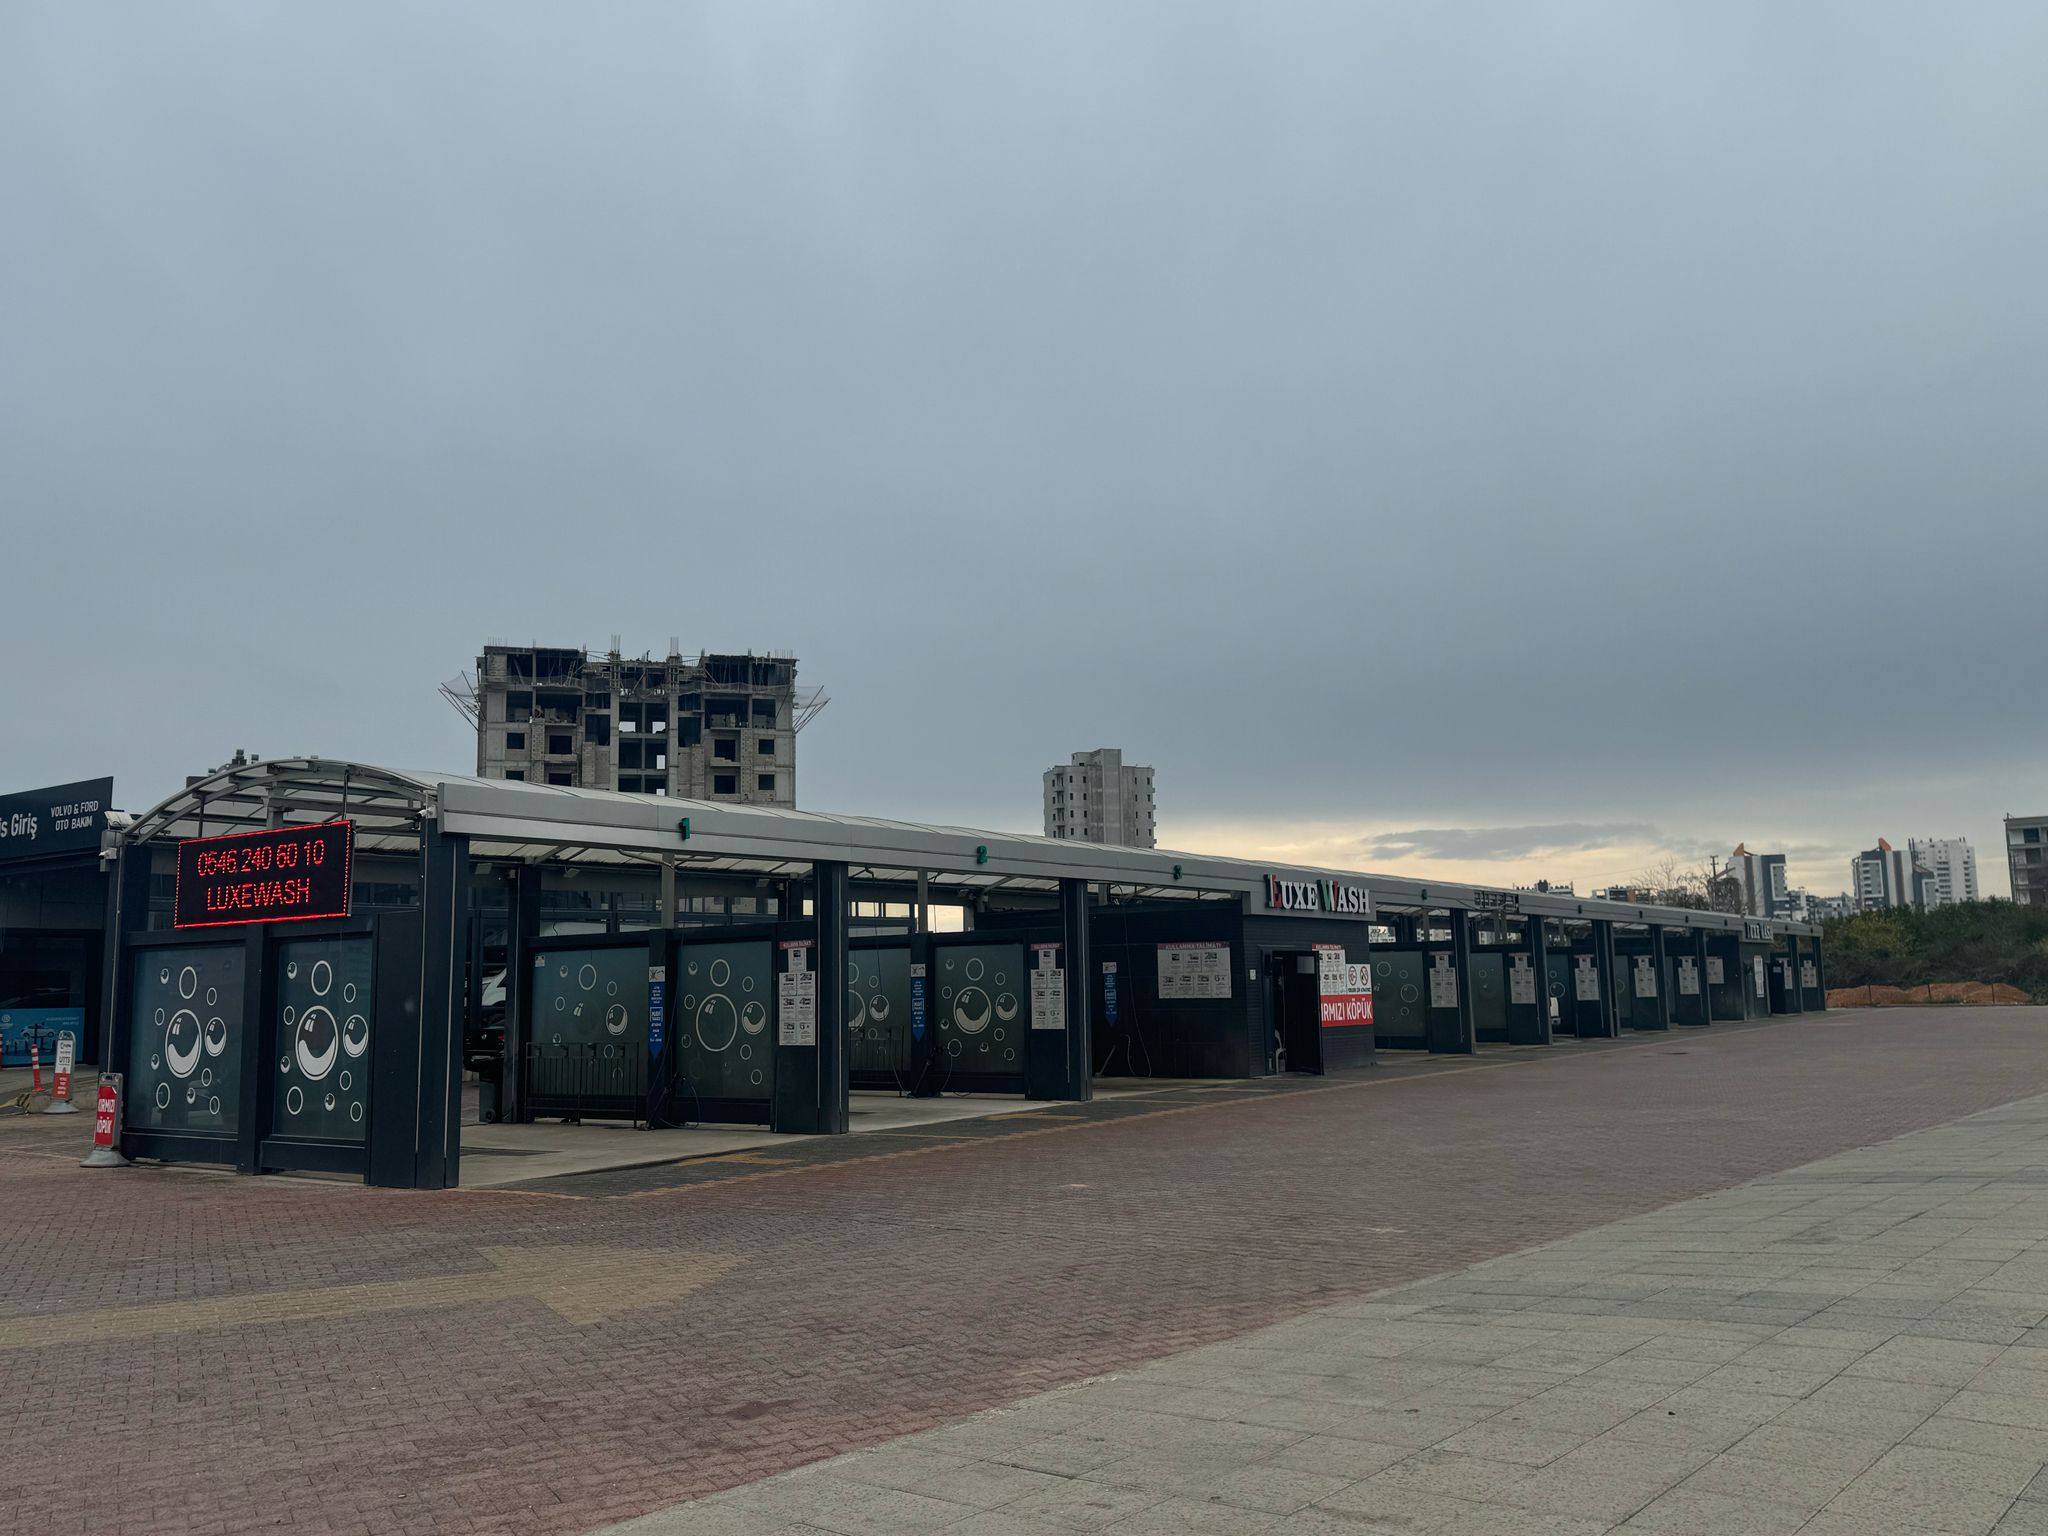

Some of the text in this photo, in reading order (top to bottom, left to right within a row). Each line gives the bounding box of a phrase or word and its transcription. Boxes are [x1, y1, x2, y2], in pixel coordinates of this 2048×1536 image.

[51, 800, 99, 818] VOLVO & FORD
[11, 812, 38, 840] Giriş
[55, 820, 69, 831] OTO
[197, 840, 325, 876] 0546 240 60 10
[207, 878, 310, 910] LUXEWASH
[1264, 874, 1371, 914] LUXE WASH
[1321, 998, 1373, 1021] IRMIZI KÖPÜK
